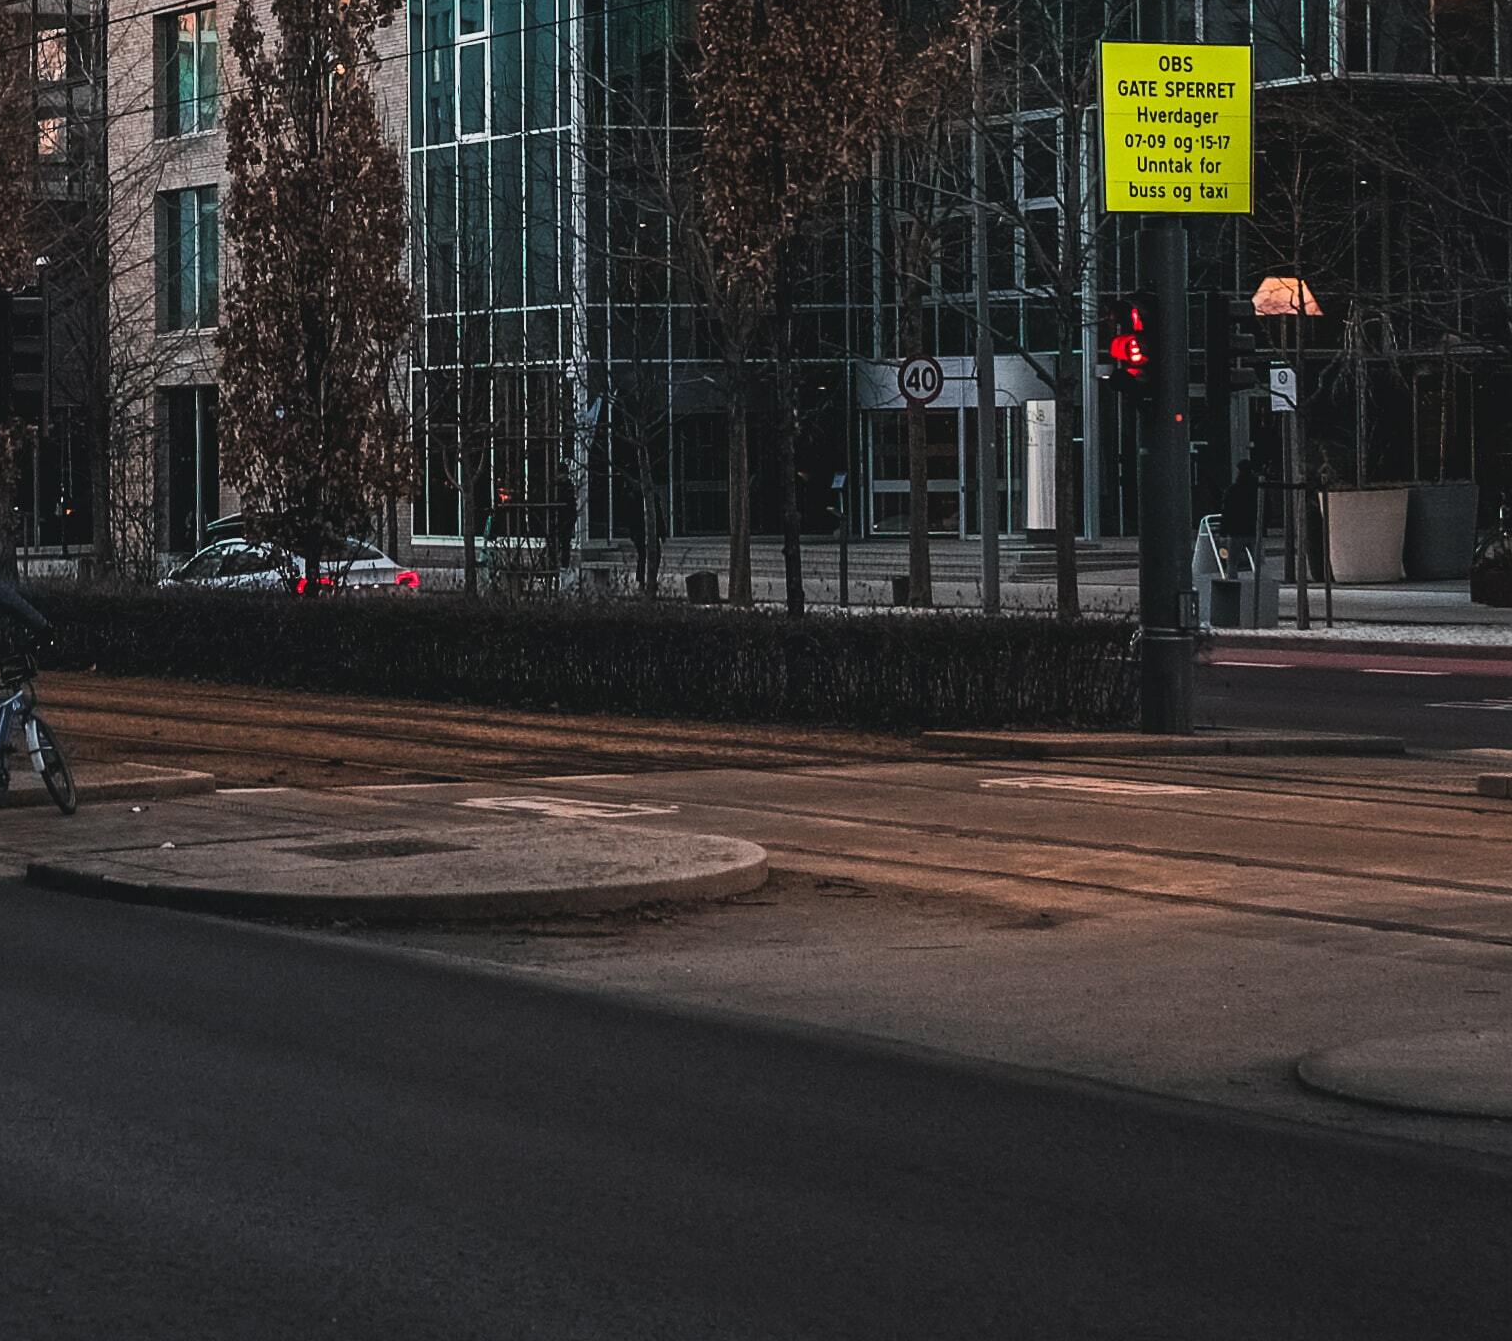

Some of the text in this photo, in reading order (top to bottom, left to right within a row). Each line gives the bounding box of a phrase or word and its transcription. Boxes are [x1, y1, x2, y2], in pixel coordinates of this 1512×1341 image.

[1158, 55, 1193, 72] OBS
[1117, 80, 1236, 98] GATE SPERRET
[1137, 107, 1219, 127] Hverdager
[1125, 134, 1230, 153] 07-09 og 15-17
[1137, 157, 1222, 173] Unntak for
[1129, 181, 1228, 202] buss og taxi
[906, 367, 937, 392] 40
